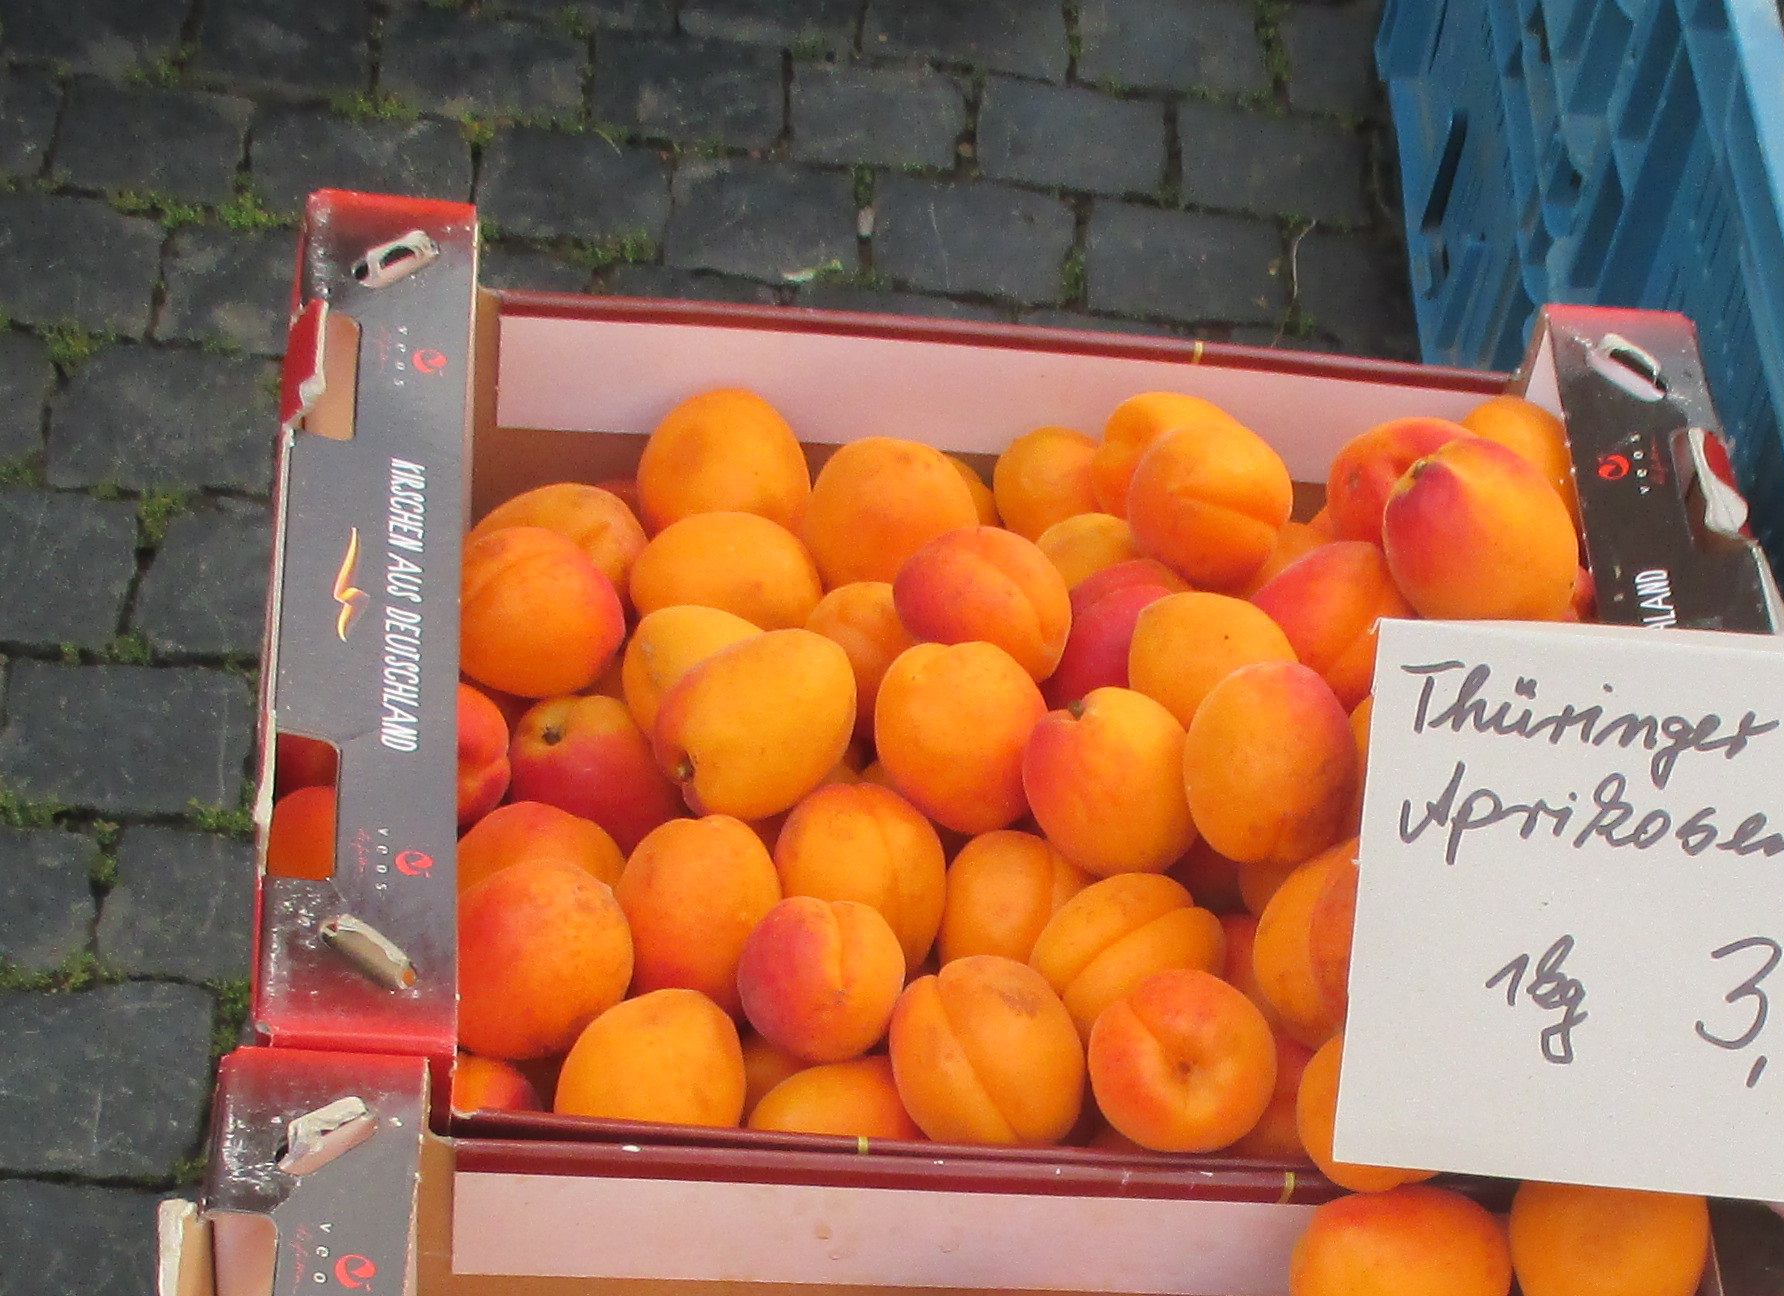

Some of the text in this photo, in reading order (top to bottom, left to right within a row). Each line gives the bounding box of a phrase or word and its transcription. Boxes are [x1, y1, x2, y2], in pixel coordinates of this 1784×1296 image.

[380, 457, 427, 752] KIRSCHEN AUS DEUTSCHLAND
[1402, 661, 1780, 788] Thüringer
